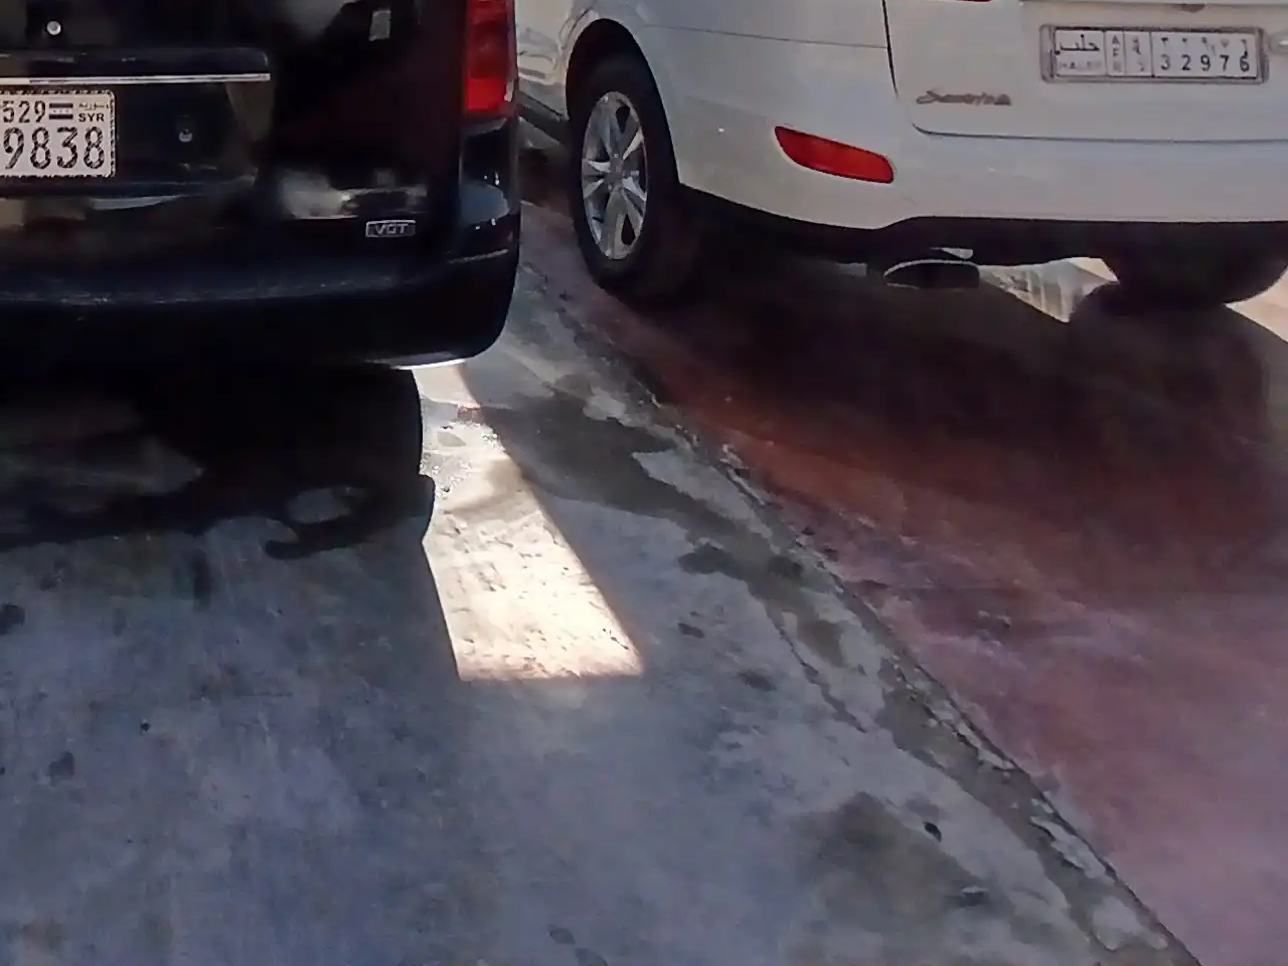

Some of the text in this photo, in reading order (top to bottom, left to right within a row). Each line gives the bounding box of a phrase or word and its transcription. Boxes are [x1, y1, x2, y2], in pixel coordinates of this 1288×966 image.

[2, 100, 46, 123] 529
[78, 113, 105, 123] SYR
[2, 126, 105, 170] 9838
[375, 223, 409, 234] VGT
